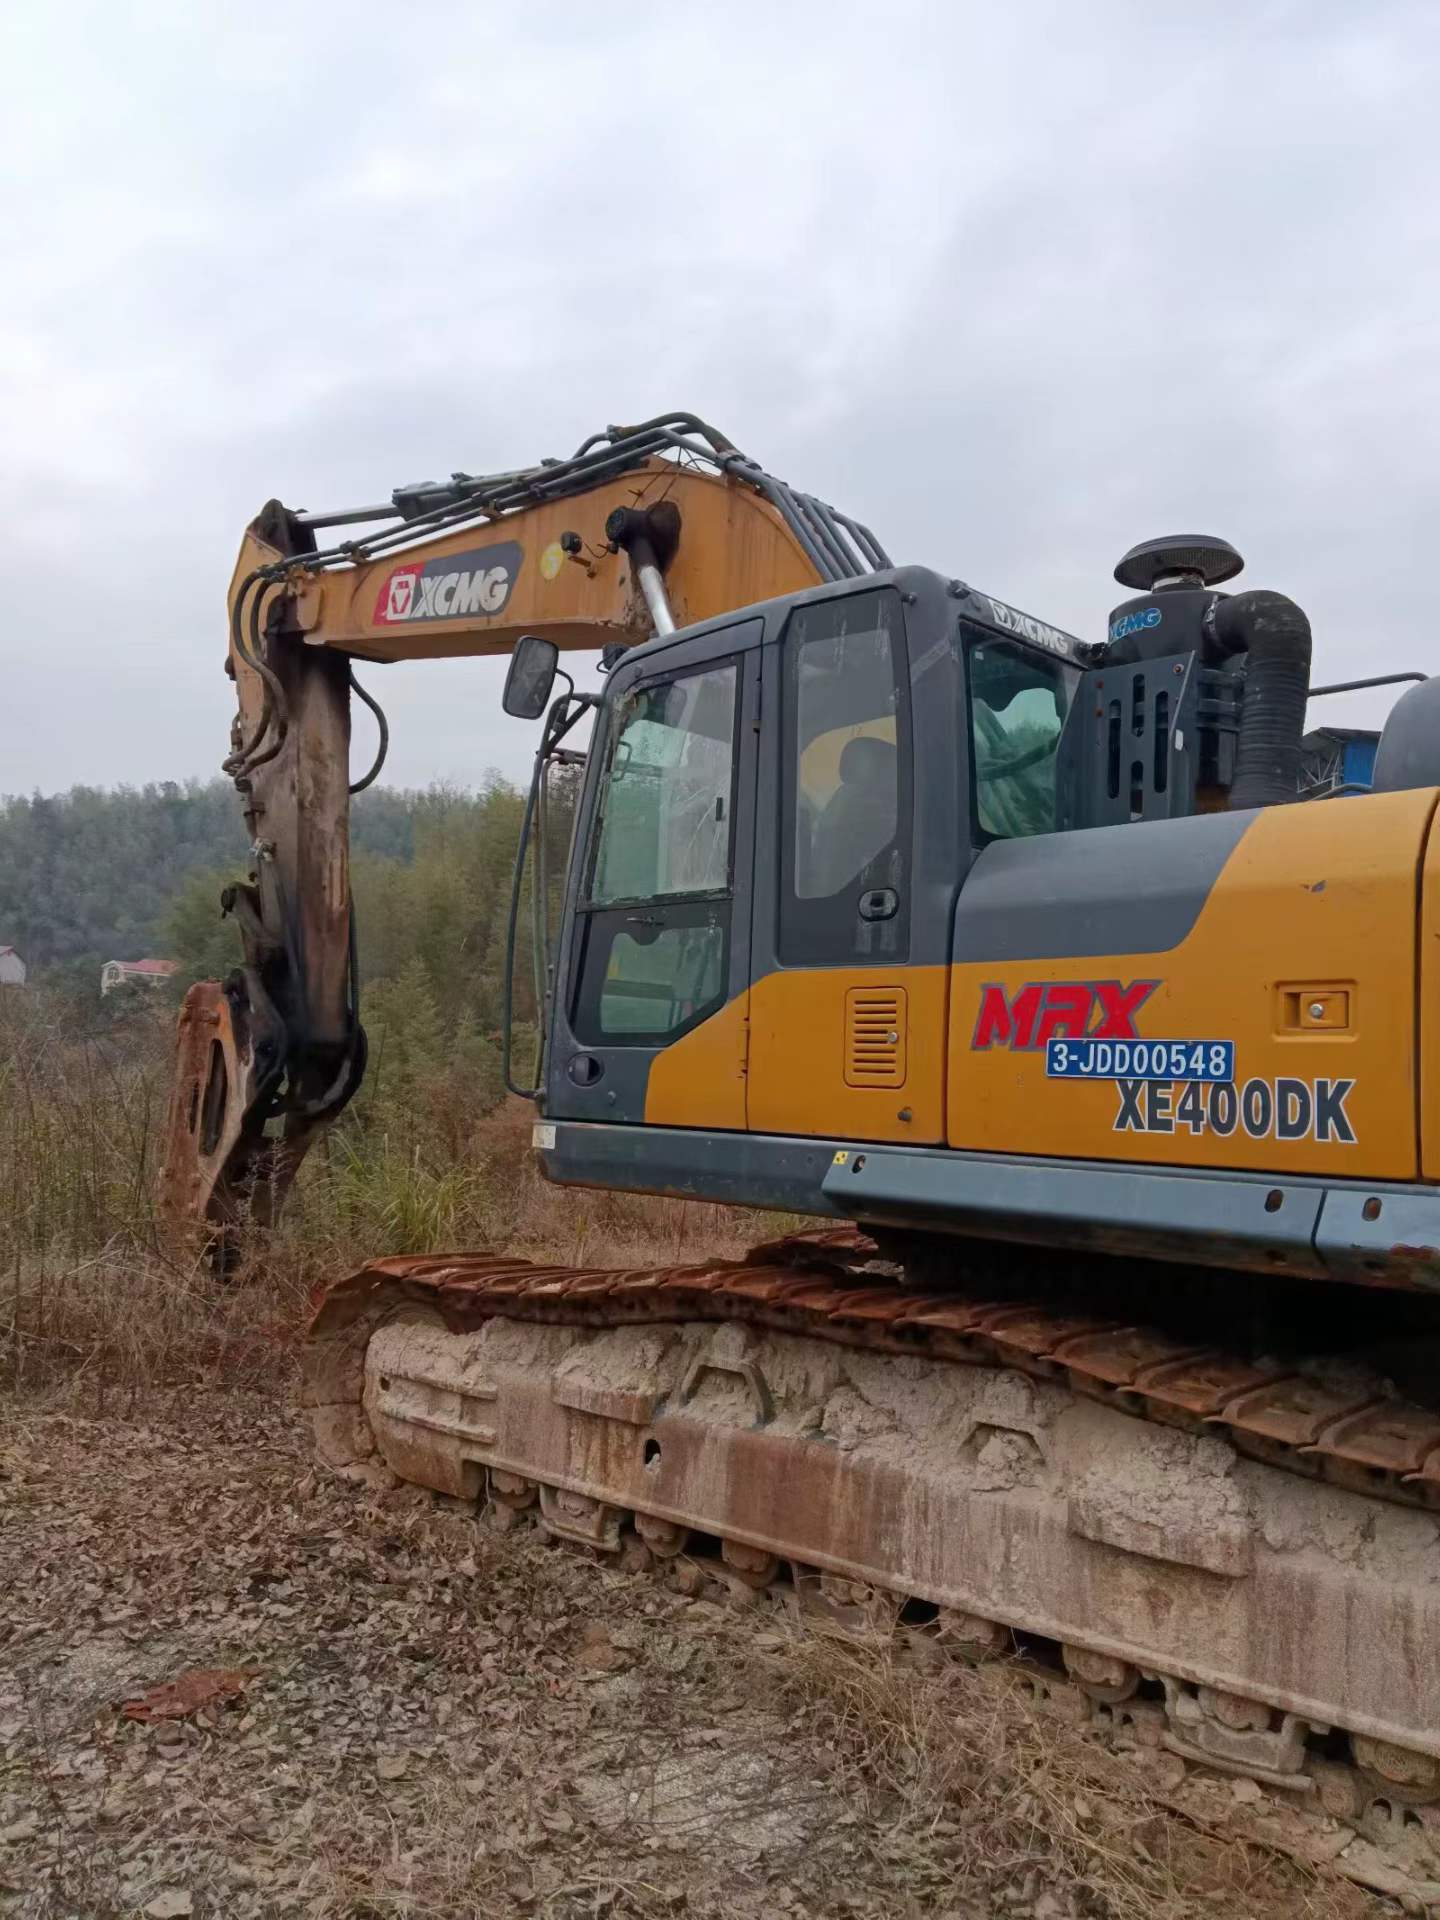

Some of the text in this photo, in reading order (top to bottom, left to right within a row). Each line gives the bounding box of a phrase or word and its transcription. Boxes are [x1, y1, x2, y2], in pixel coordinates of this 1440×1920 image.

[412, 566, 508, 617] XCMG
[1011, 609, 1068, 654] XCMG
[971, 980, 1164, 1053] MAX
[1053, 1043, 1227, 1077] 3-JDD00548
[1112, 1077, 1359, 1144] XE400DK
